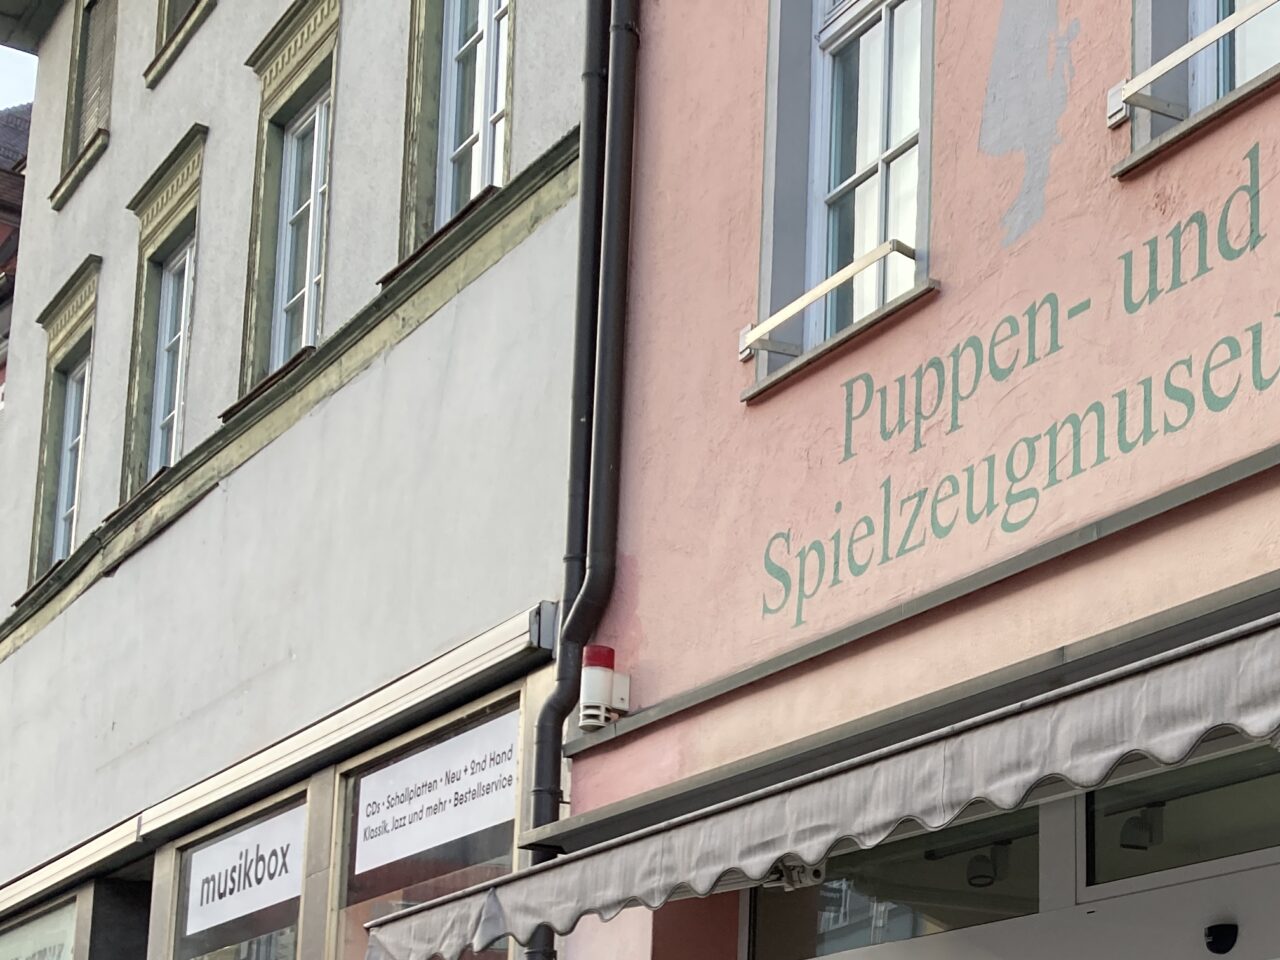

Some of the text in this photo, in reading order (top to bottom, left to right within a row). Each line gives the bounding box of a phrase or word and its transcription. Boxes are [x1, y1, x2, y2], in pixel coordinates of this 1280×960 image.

[838, 141, 1267, 464] Puppen- und
[363, 774, 514, 842] Klassik, Jazz und mehr Bestellservice
[366, 802, 380, 818] CDs
[386, 779, 438, 810] Schallplatten
[444, 770, 462, 786] Neu
[470, 755, 486, 776] 2nd
[488, 743, 514, 768] Hand
[200, 843, 291, 907] musikbox
